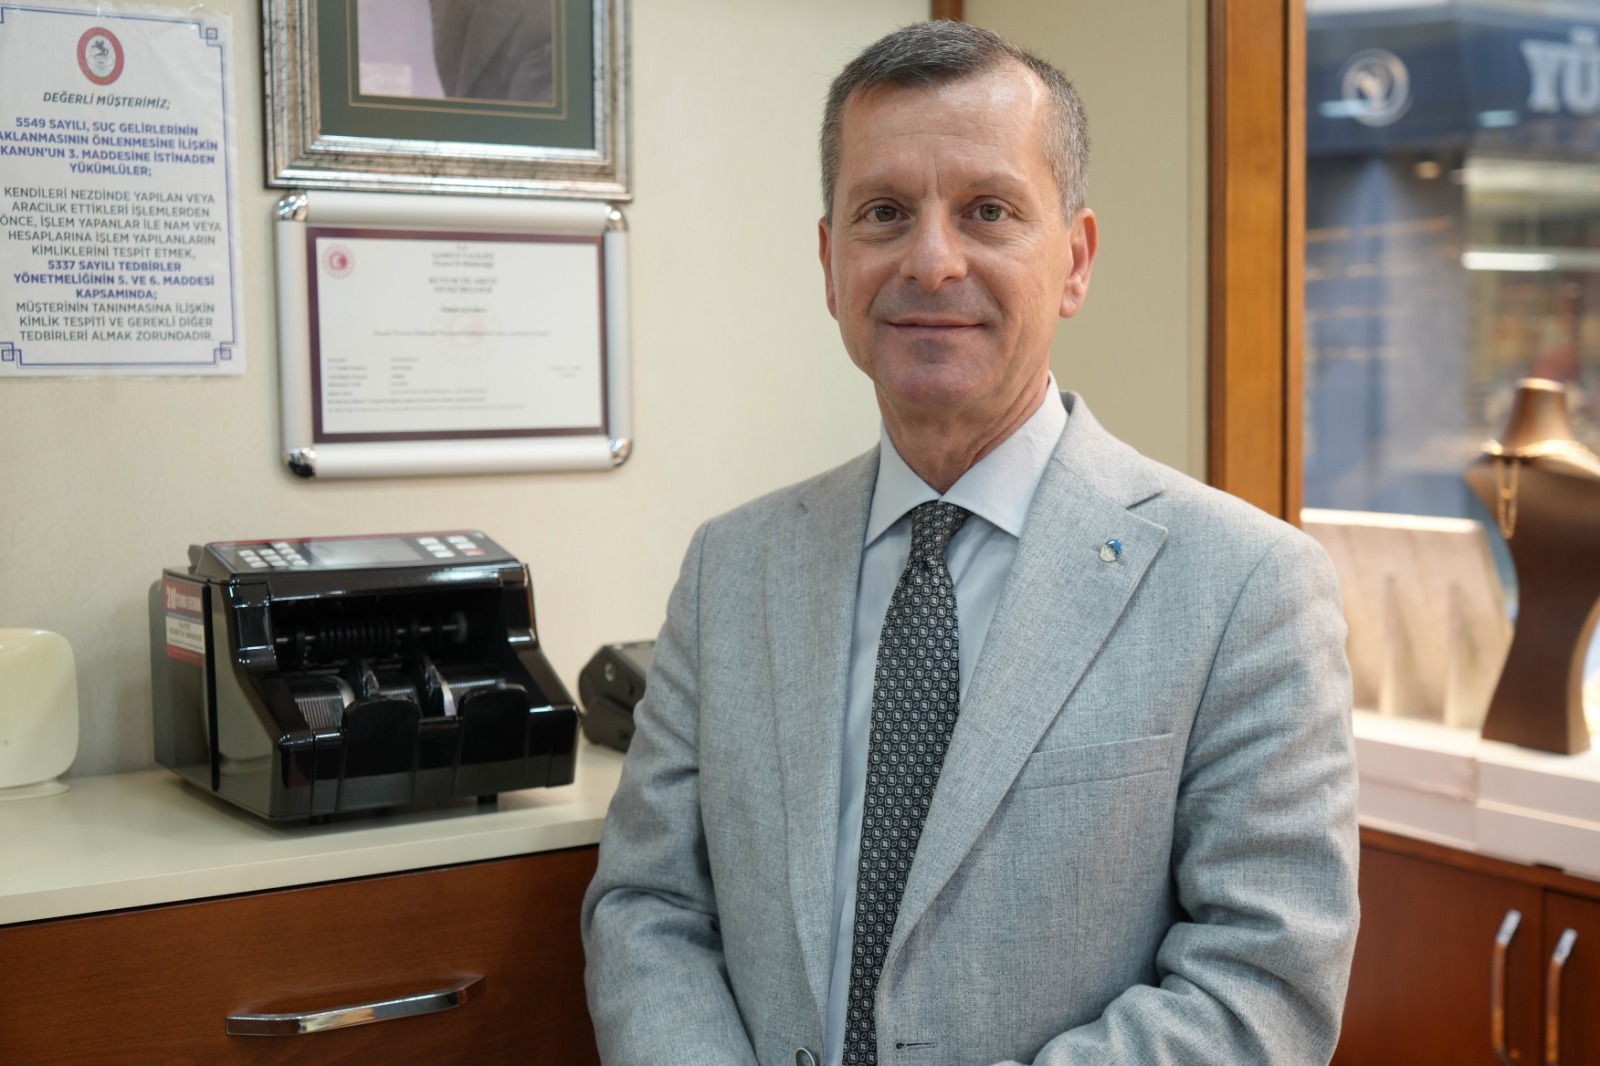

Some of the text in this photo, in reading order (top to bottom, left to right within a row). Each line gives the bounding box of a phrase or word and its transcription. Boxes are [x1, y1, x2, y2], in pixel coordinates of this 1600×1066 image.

[43, 91, 171, 110] DEĞERLİ MÜŞTERİMİZ;
[16, 117, 198, 136] 5549 SAYILI, SUÇ GELİRLERİNİN
[0, 131, 218, 151] KLANMASININ ÖNLENMESİNE İLİŞKİN
[1, 146, 214, 164] KANUN'UN 3. MADDESİNE İSTİNADEN
[69, 162, 152, 177] YÜKÜMLÜLER;
[4, 186, 215, 204] KENDİLERİ NEZDİNDE YAPILAN VEYA
[12, 202, 210, 217] ARACILIK ETTİKLERİ İŞLEMLERDEN
[0, 214, 221, 231] ÖNCE, İŞLEM YAPANLAR İLE NAM VEYA
[9, 231, 215, 245] HESAPLARINA İŞLEM YAPILANLARIN
[32, 243, 195, 259] KİMLİKLERİNİ TESPİT ETMEK,
[48, 260, 181, 271] 5337 SAYILI TEDBİRLER
[14, 272, 214, 285] YÖNETMELİĞİNİN 5. VE 6. MADDESİ
[76, 289, 157, 300] KAPSAMINDA;
[17, 301, 214, 314] MÜŞTERİNİN TANINMASINA İLİŞKİN
[19, 315, 212, 327] KİMLİK TESPİTİ VE GEREKLİ DİĞER
[20, 329, 214, 341] TEDBİRLERİ ALMAK ZORUNDADIR.
